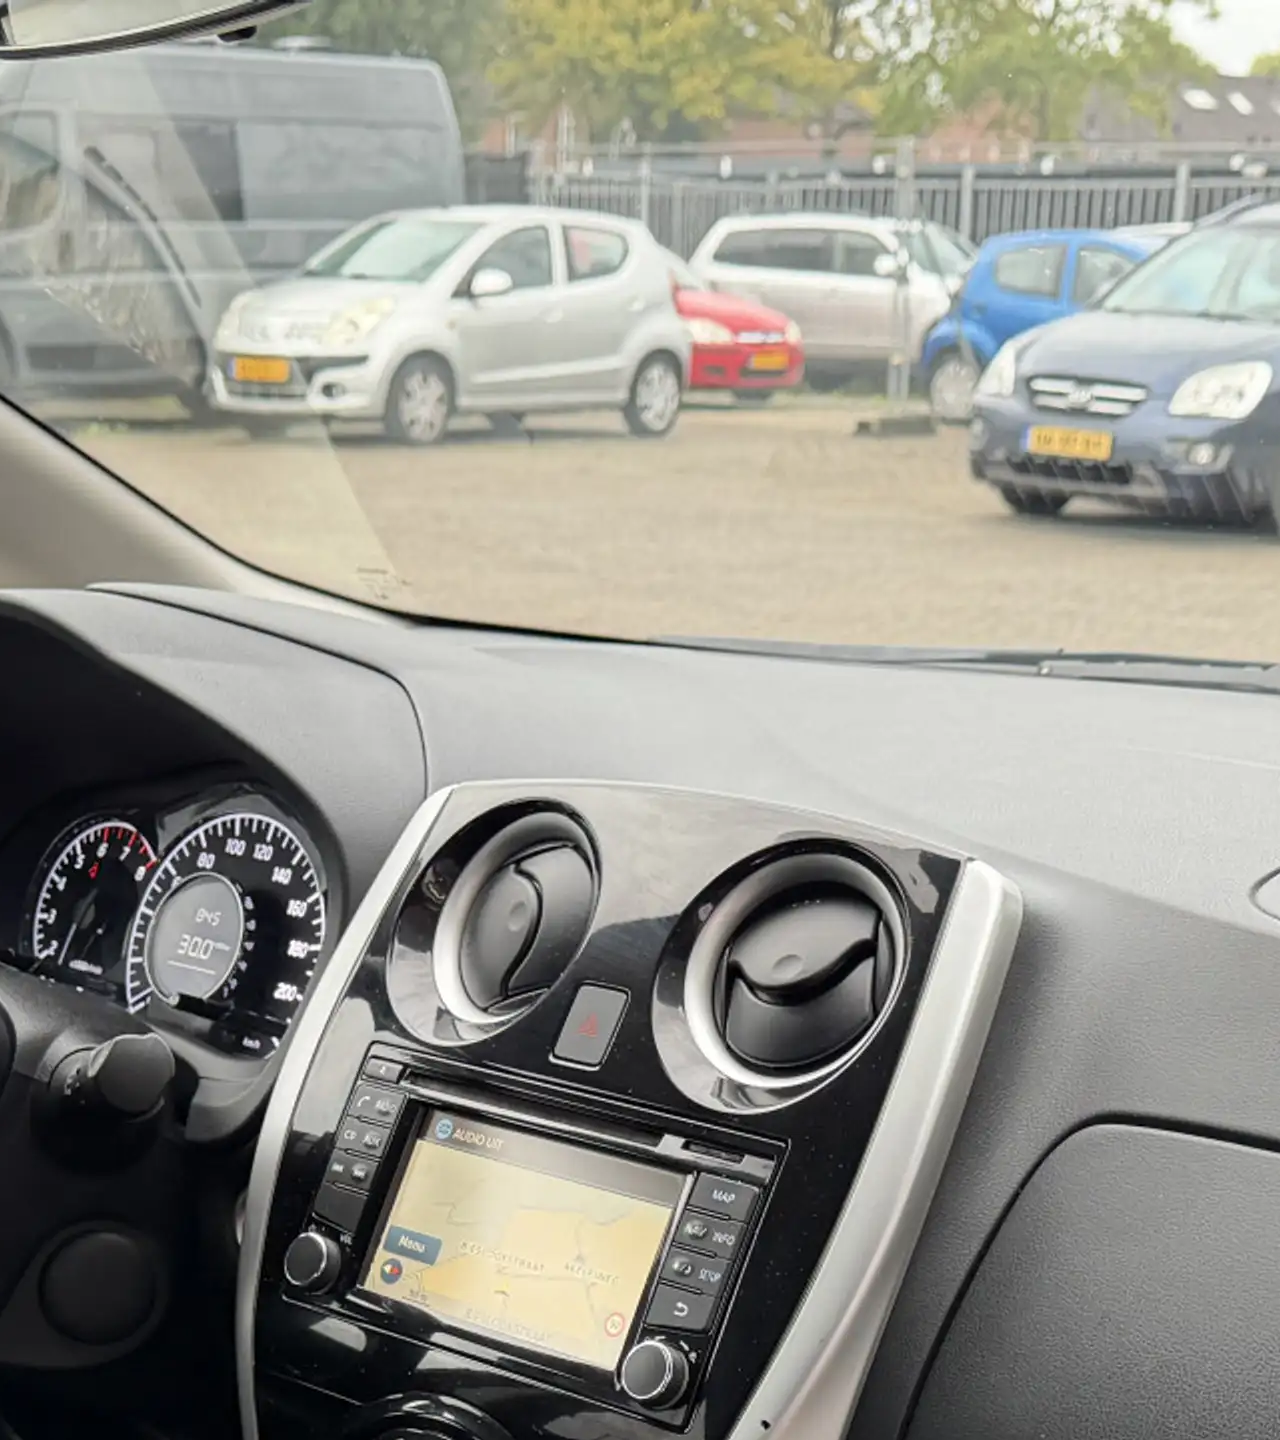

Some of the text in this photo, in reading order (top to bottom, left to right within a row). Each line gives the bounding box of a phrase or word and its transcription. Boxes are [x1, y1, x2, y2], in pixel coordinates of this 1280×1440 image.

[225, 837, 247, 857] 100
[253, 843, 274, 862] 120
[196, 851, 216, 870] 80
[272, 865, 293, 885] 140
